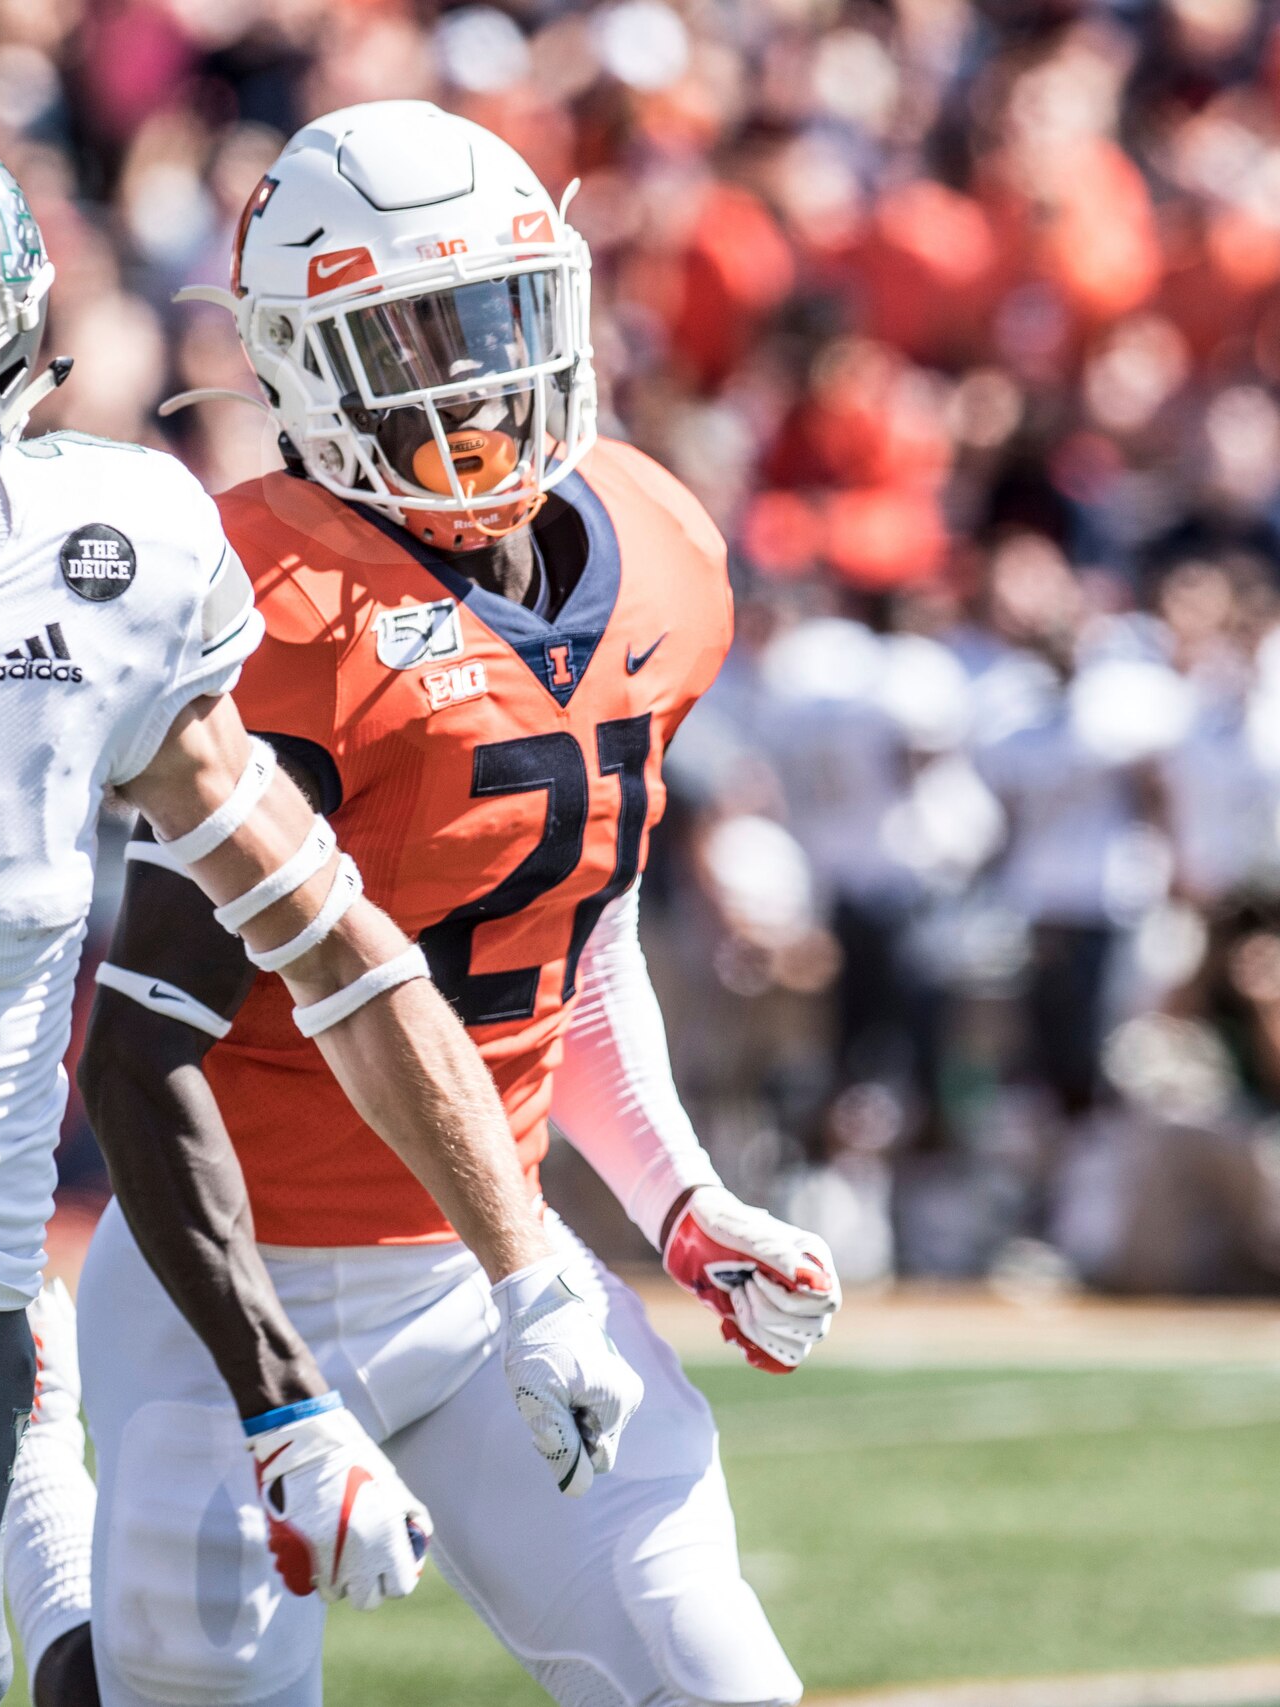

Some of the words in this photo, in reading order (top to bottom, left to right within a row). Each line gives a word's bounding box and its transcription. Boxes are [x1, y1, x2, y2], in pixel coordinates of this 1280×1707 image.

[78, 539, 119, 559] THE
[68, 559, 131, 580] DEUCE
[547, 643, 574, 687] I
[417, 711, 653, 1026] 21
